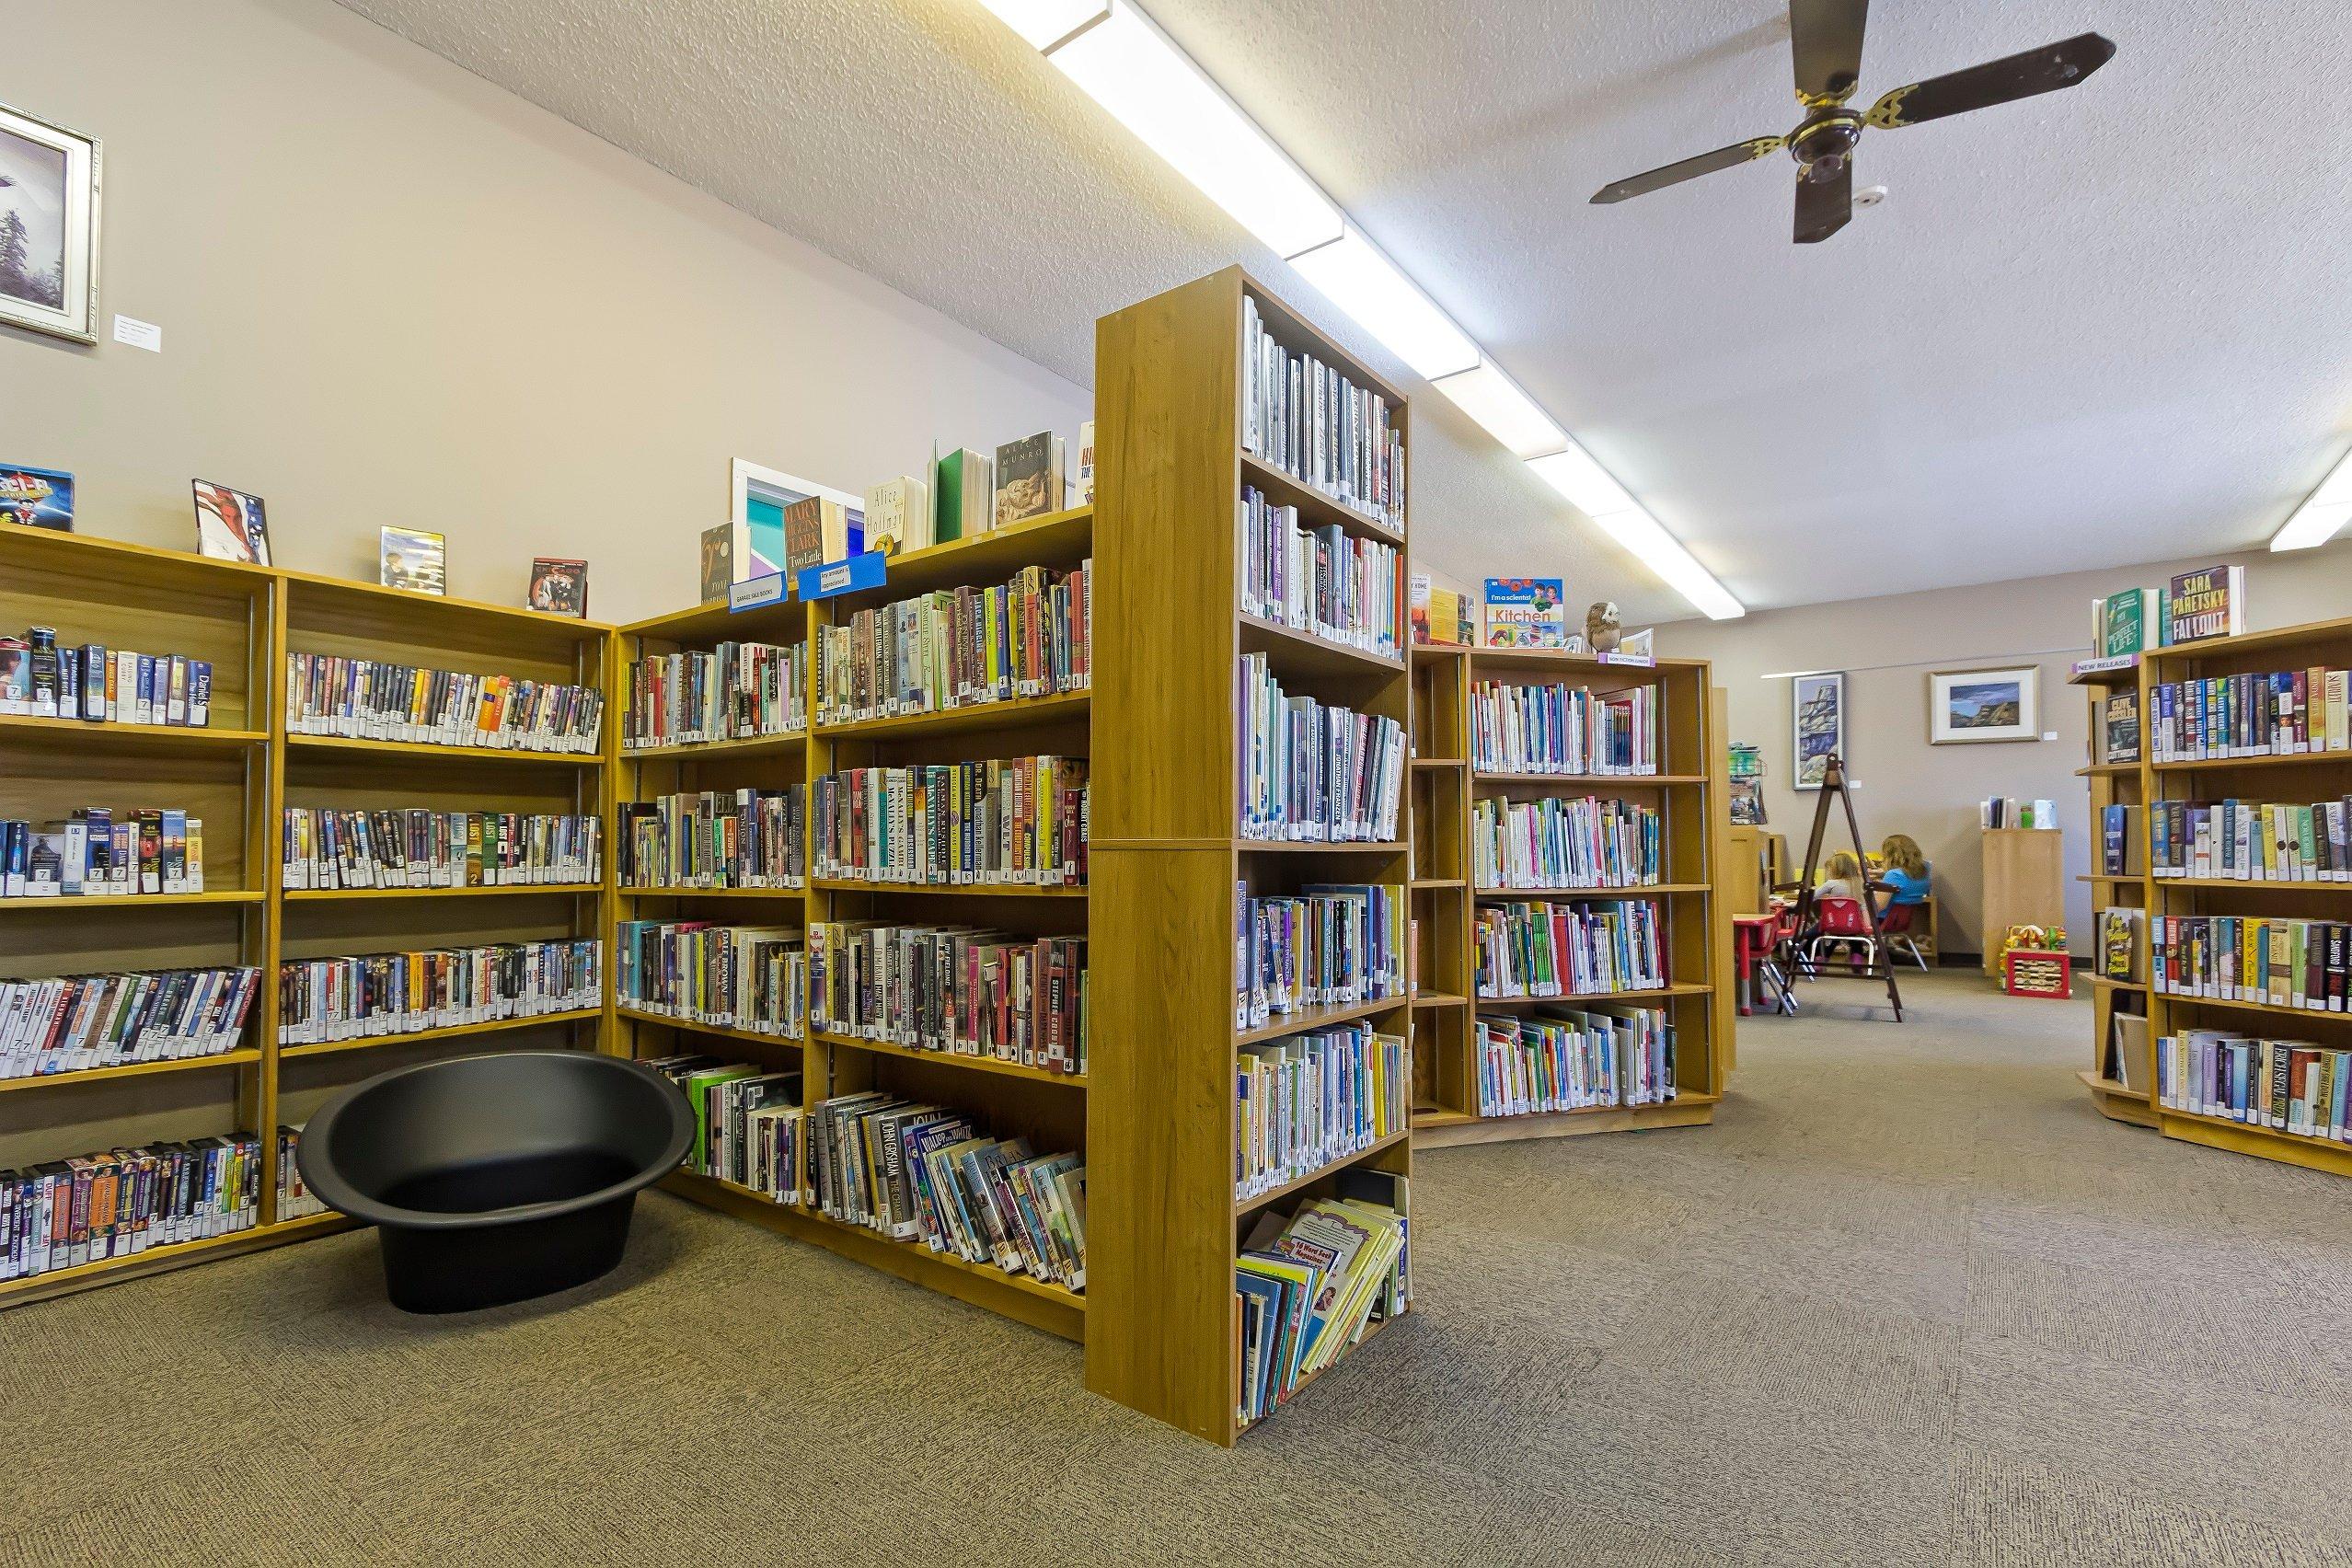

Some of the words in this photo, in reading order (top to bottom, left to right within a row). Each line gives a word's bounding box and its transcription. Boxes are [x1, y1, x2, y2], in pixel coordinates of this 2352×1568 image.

[874, 489, 897, 508] Alice
[789, 555, 803, 569] Two
[802, 549, 822, 564] Little
[760, 589, 773, 597] BOOKS
[2184, 574, 2211, 596] SARA
[2173, 589, 2226, 617] PARETSKY
[1495, 609, 1551, 623] Kitchen
[2078, 662, 2095, 672] NEW
[2097, 658, 2132, 671] RELEASES
[199, 674, 209, 700] Daniel
[888, 786, 896, 832] McNALLY'S
[974, 806, 985, 836] jonathan
[888, 836, 896, 868] PUZZL
[974, 836, 985, 870] kellerman
[2330, 939, 2341, 965] SANDFORD
[2273, 1047, 2288, 1071] ERICH
[2273, 1071, 2288, 1095] SEGAL
[882, 1123, 895, 1144] JOHN
[883, 1143, 901, 1177] GRISHAM
